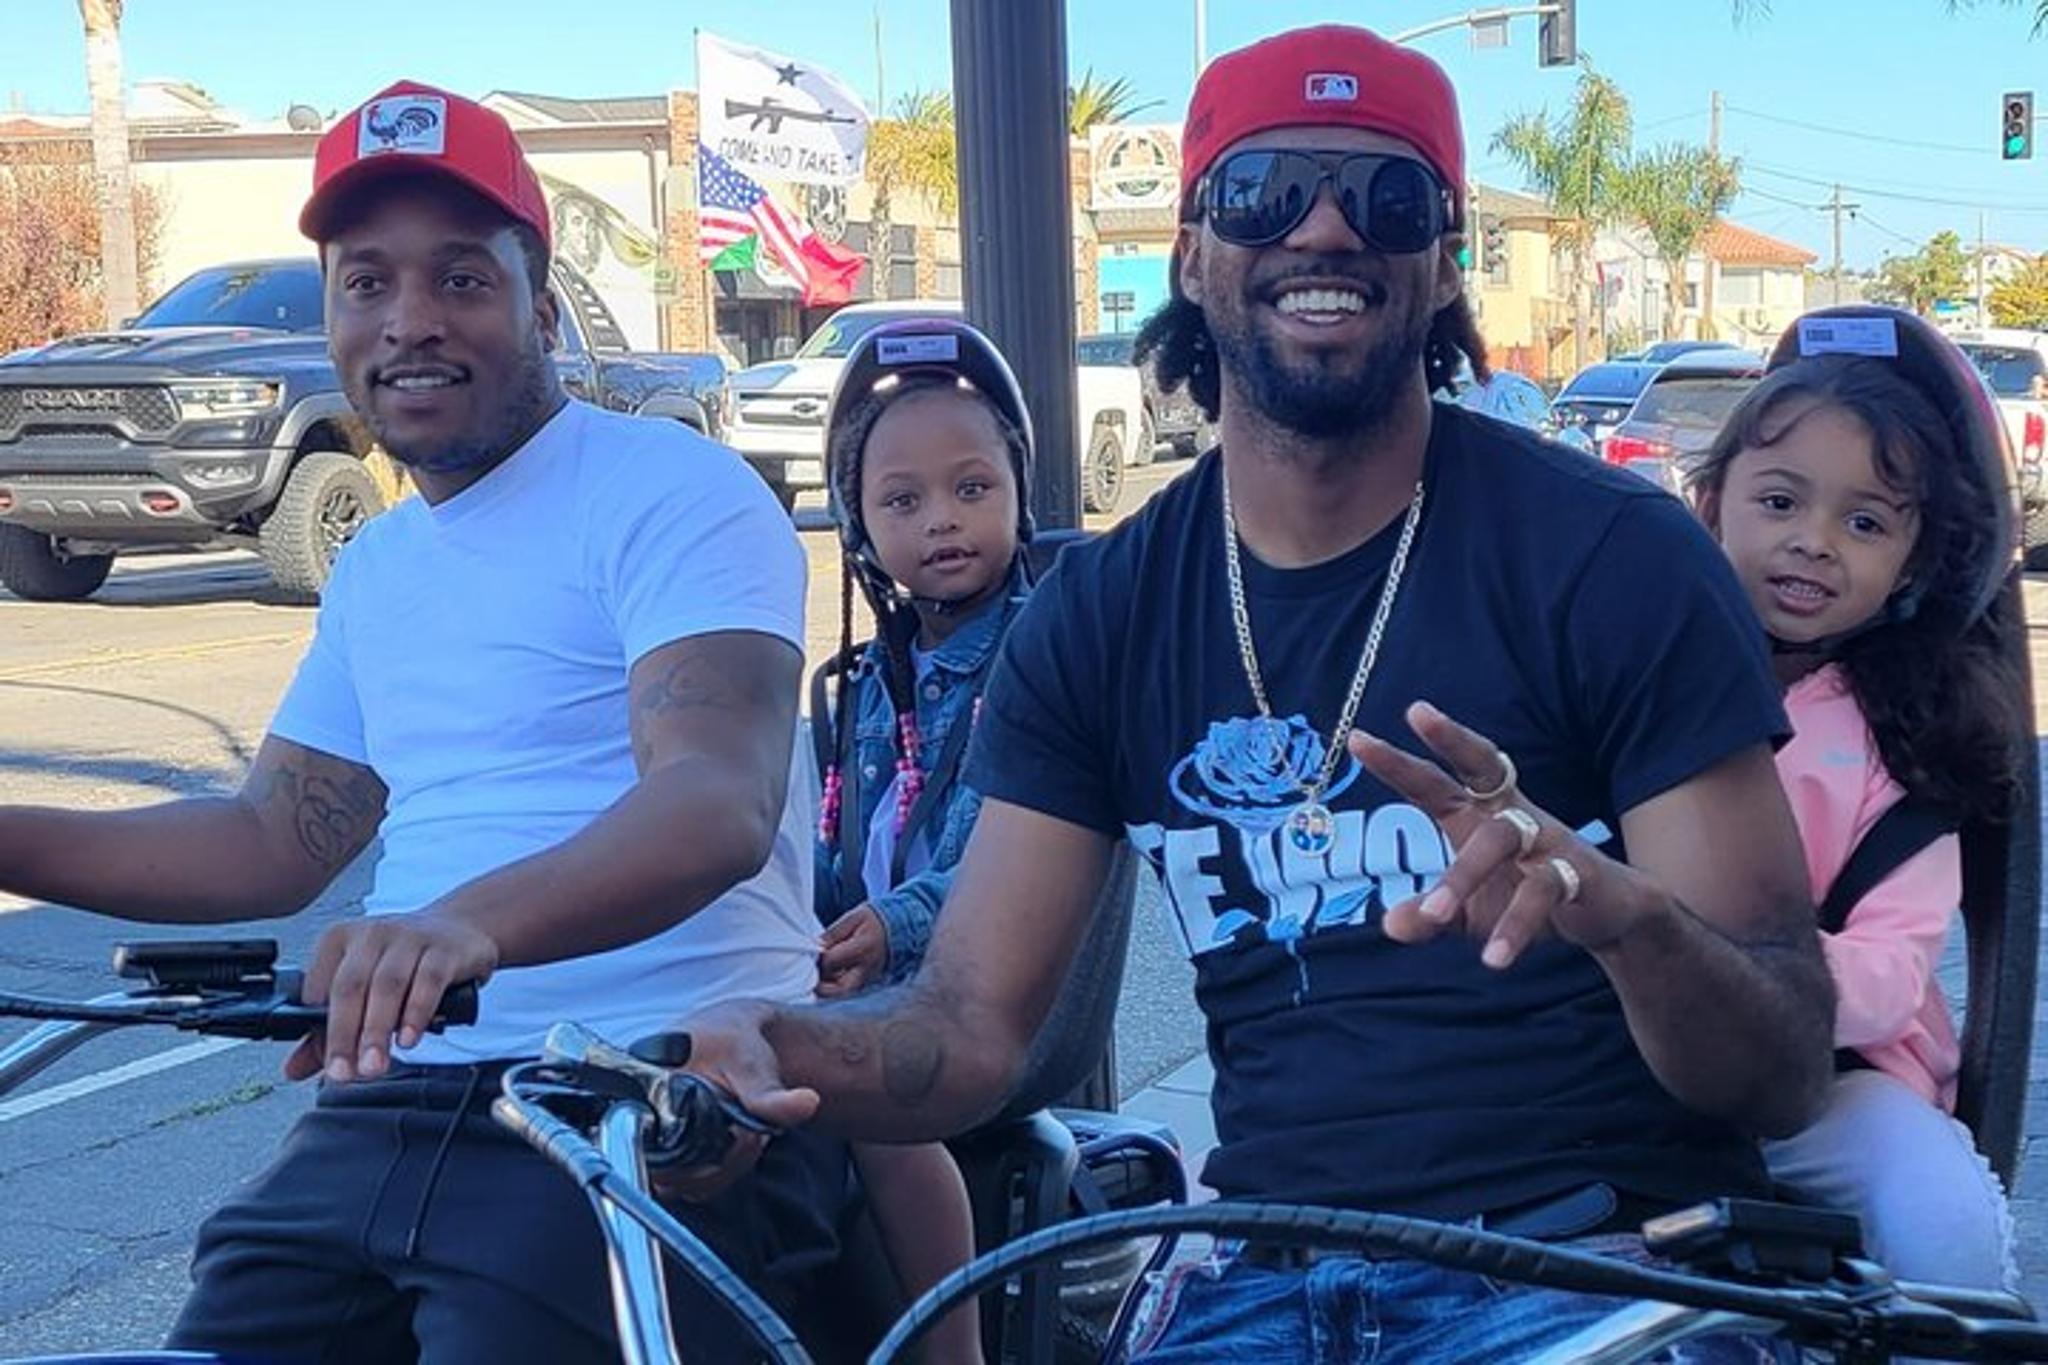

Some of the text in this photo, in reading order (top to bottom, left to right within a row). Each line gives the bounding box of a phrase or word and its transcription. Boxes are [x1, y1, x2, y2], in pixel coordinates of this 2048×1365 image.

[720, 137, 760, 164] COME
[797, 147, 839, 176] TAKE
[22, 389, 122, 411] RAM
